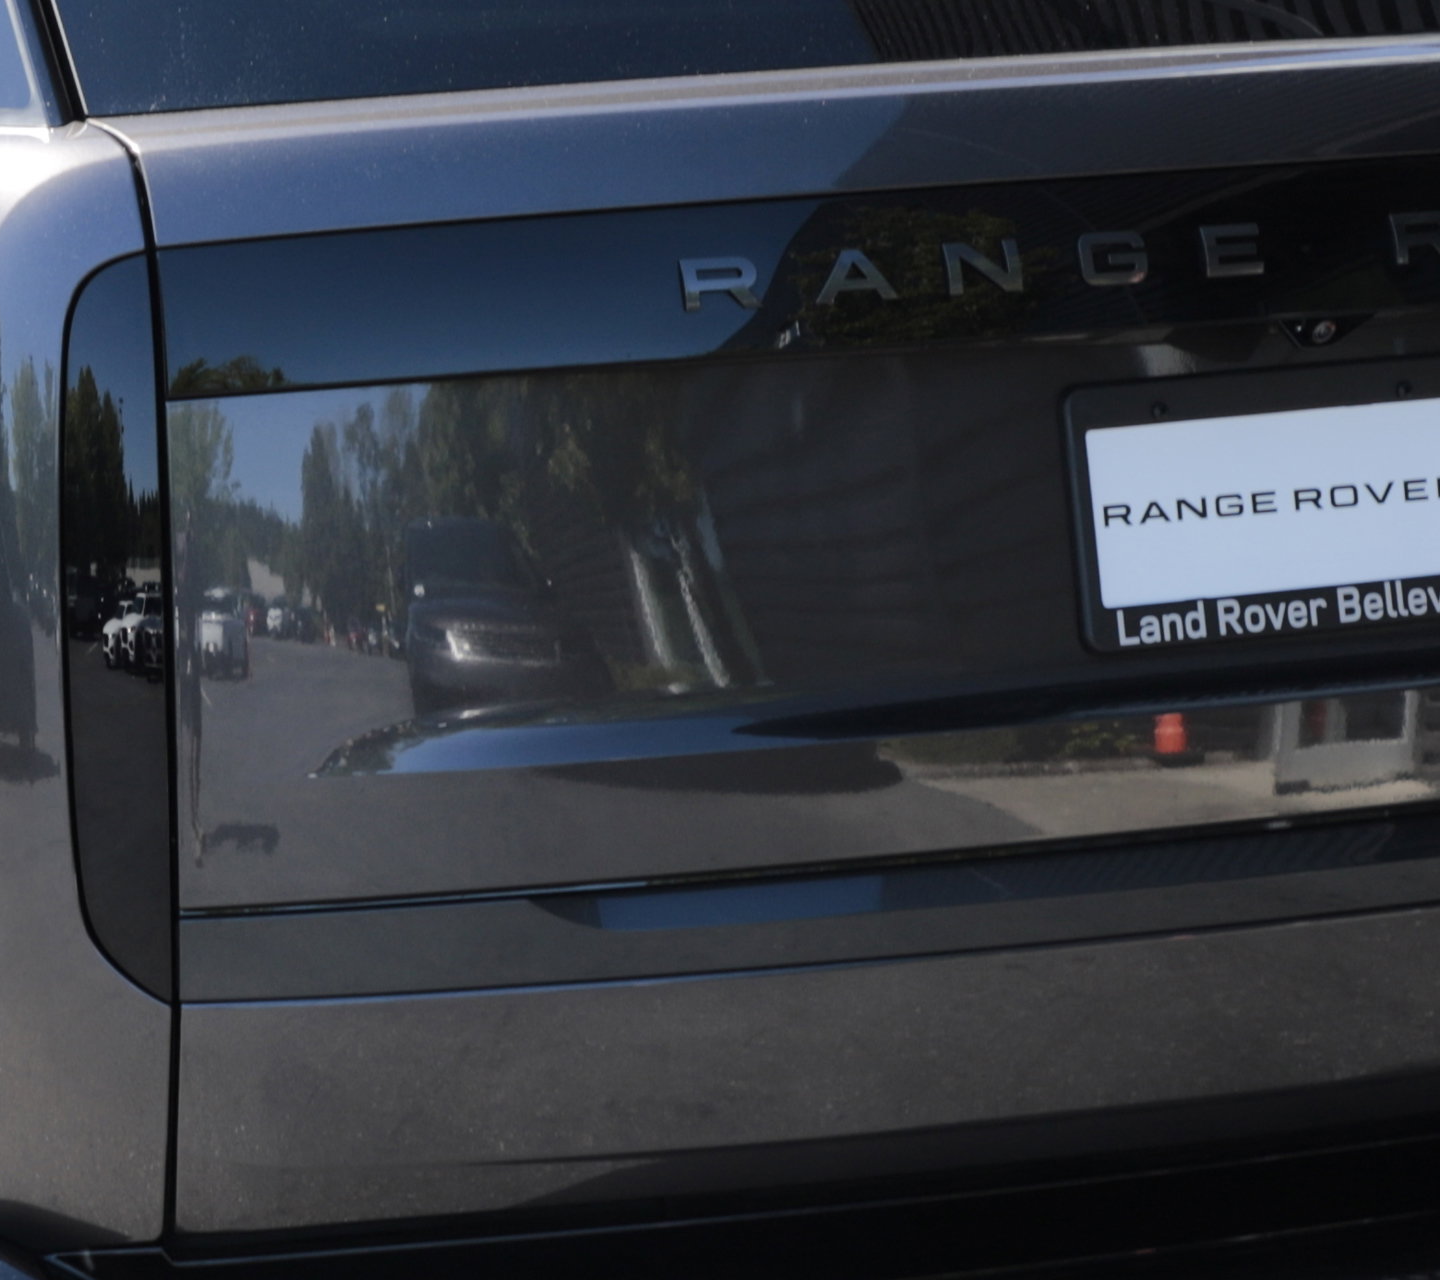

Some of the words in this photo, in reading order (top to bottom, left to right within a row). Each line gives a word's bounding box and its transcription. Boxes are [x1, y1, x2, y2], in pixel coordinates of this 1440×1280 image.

[678, 222, 1265, 313] RANGE
[1102, 491, 1278, 528] RANGE
[1116, 599, 1208, 647] Land
[1217, 595, 1328, 637] Rover
